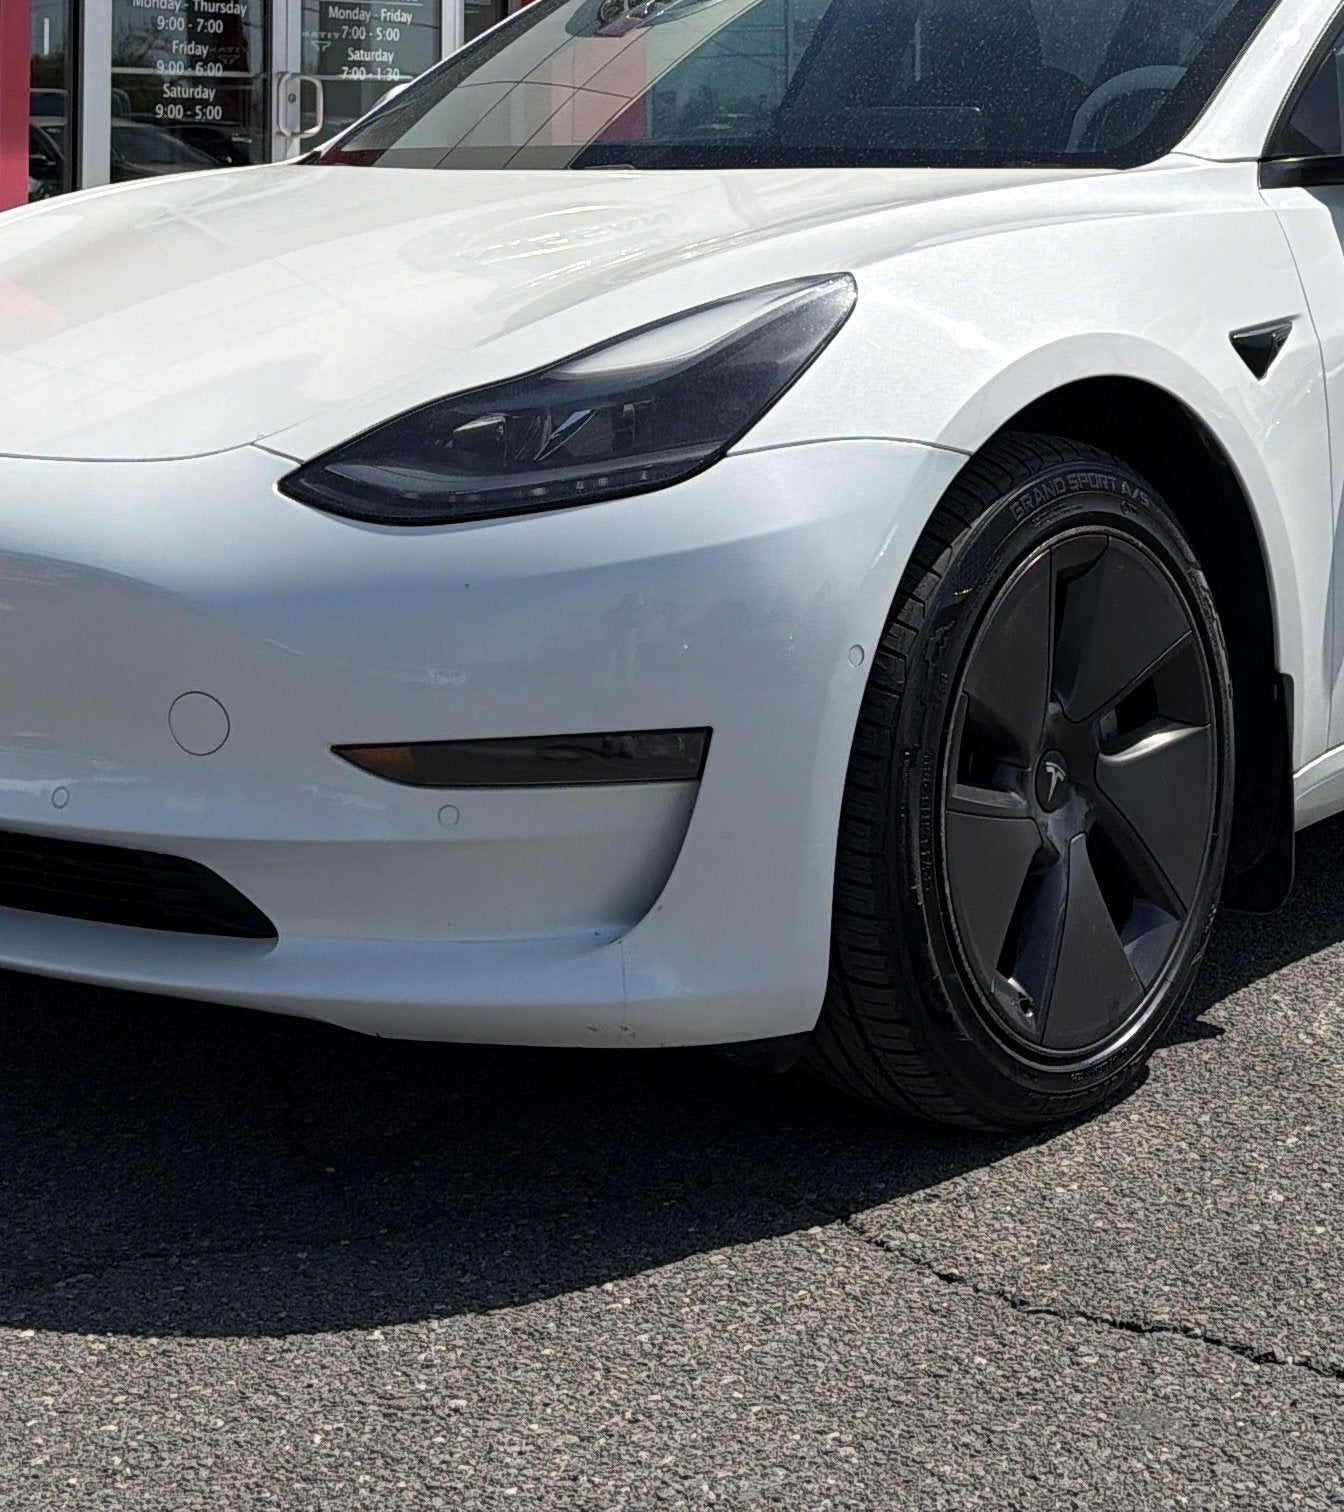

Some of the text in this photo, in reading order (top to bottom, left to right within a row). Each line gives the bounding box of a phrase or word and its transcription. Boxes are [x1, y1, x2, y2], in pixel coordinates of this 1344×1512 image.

[328, 6, 371, 23] Monday
[380, 9, 413, 25] Friday
[157, 16, 185, 31] 9:00
[196, 18, 224, 34] 7:00
[341, 26, 366, 40] 7:00
[376, 27, 400, 41] 5:00
[172, 40, 209, 59] Friday
[347, 47, 394, 64] Saturday
[156, 60, 184, 74] 9:00
[195, 62, 223, 77] 6:00
[341, 66, 366, 81] 7:00
[162, 83, 216, 102] Saturday
[155, 104, 184, 119] 9:00
[195, 106, 222, 120] 5:00
[1009, 479, 1066, 521] GRAND
[1067, 472, 1117, 491] SPORT
